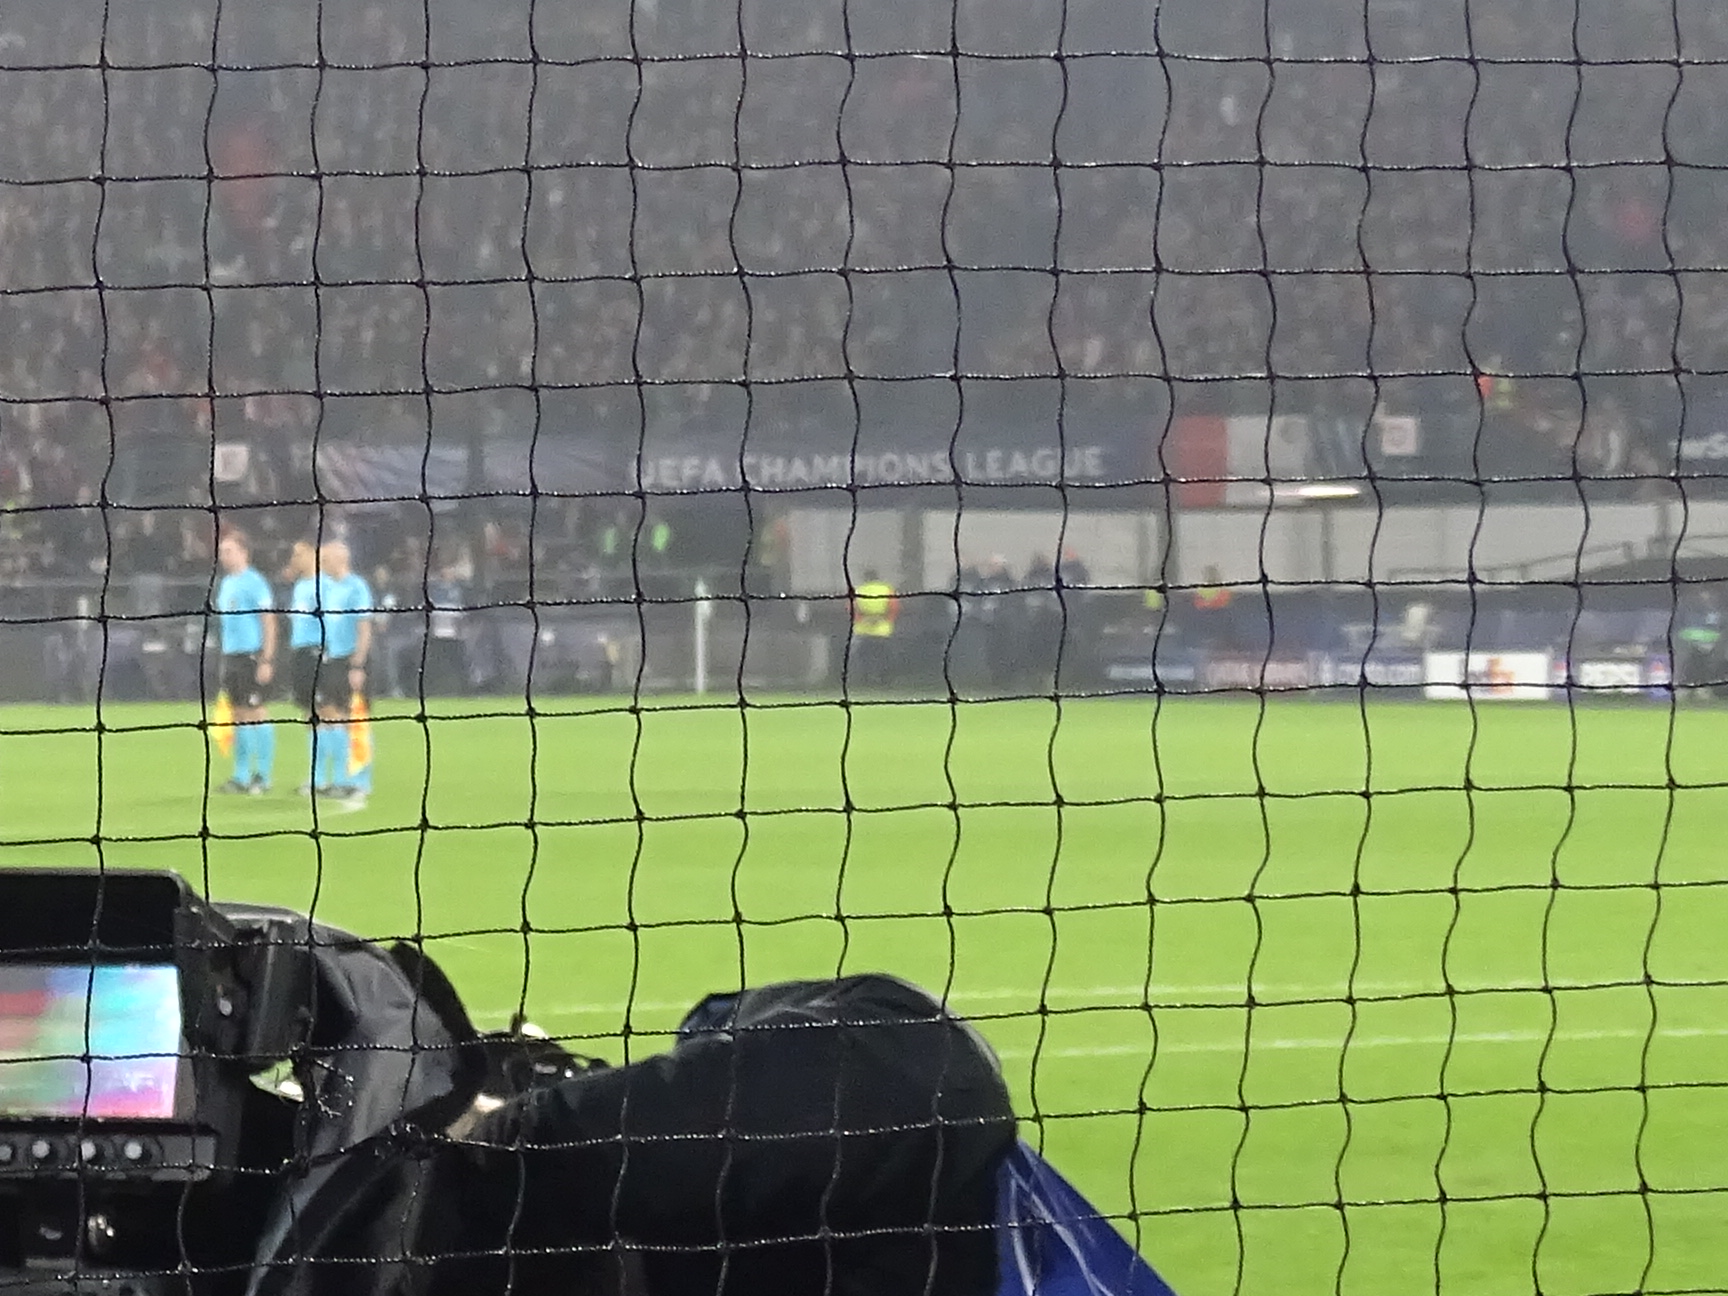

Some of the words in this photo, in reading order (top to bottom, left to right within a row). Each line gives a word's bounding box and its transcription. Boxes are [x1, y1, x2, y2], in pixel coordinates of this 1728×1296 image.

[628, 455, 725, 491] UEFA
[737, 451, 952, 489] CHAMPIONS
[965, 446, 1103, 480] LEAGUE
